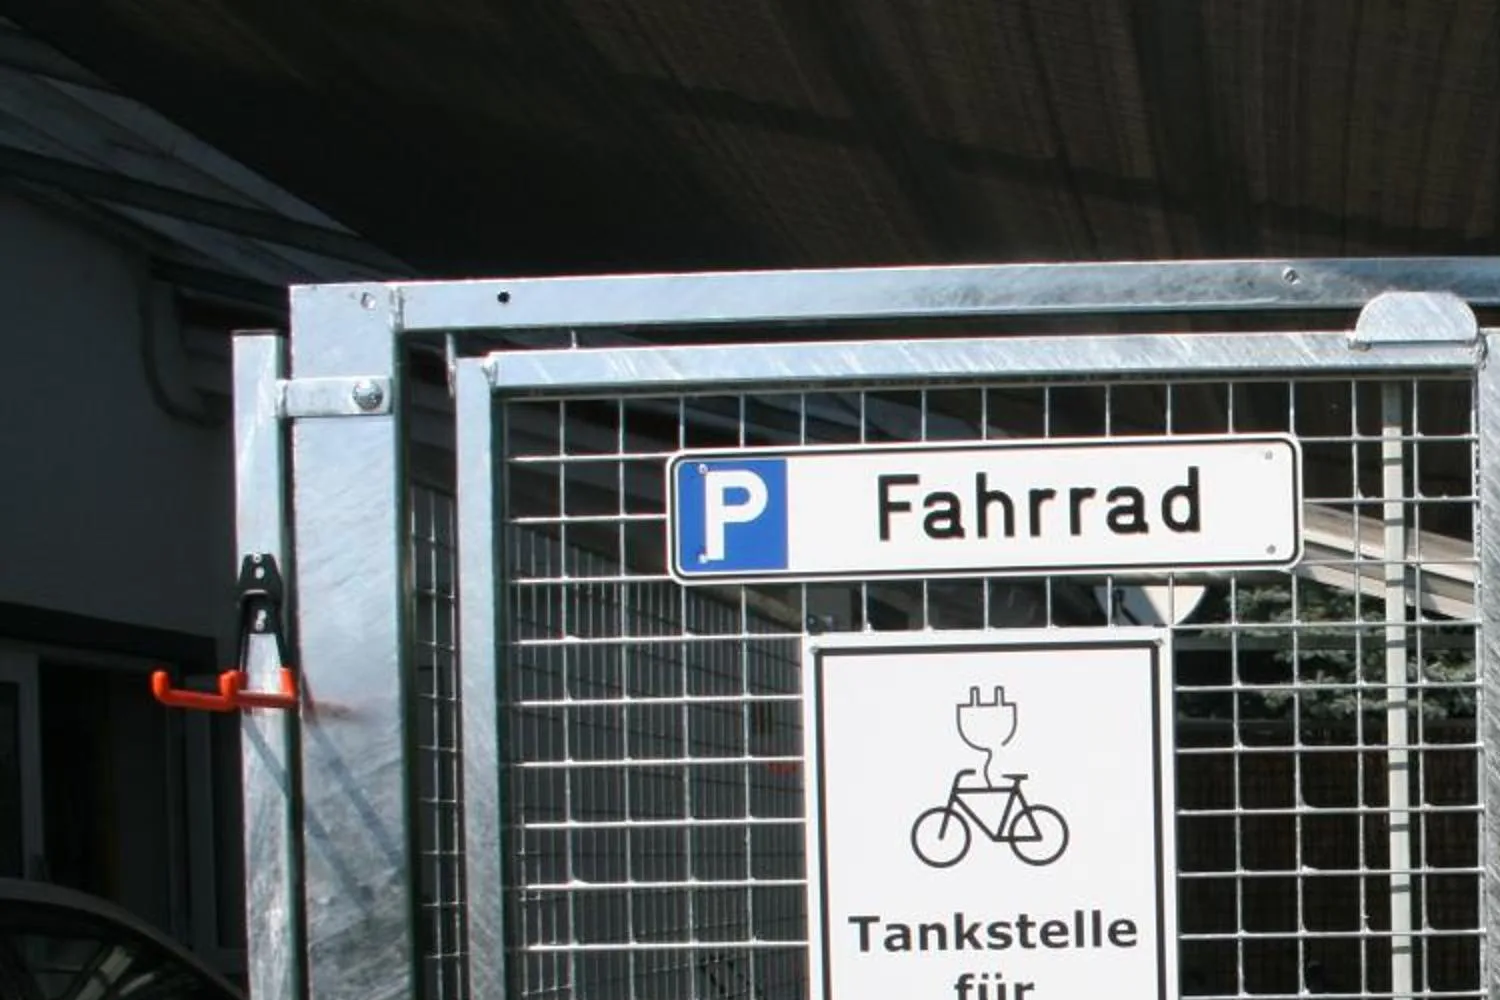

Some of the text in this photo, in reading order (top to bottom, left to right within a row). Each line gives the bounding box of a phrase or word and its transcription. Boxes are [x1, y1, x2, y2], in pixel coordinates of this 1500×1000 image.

[703, 466, 1202, 561] P Fahrrad
[847, 909, 1138, 952] Tankstelle
